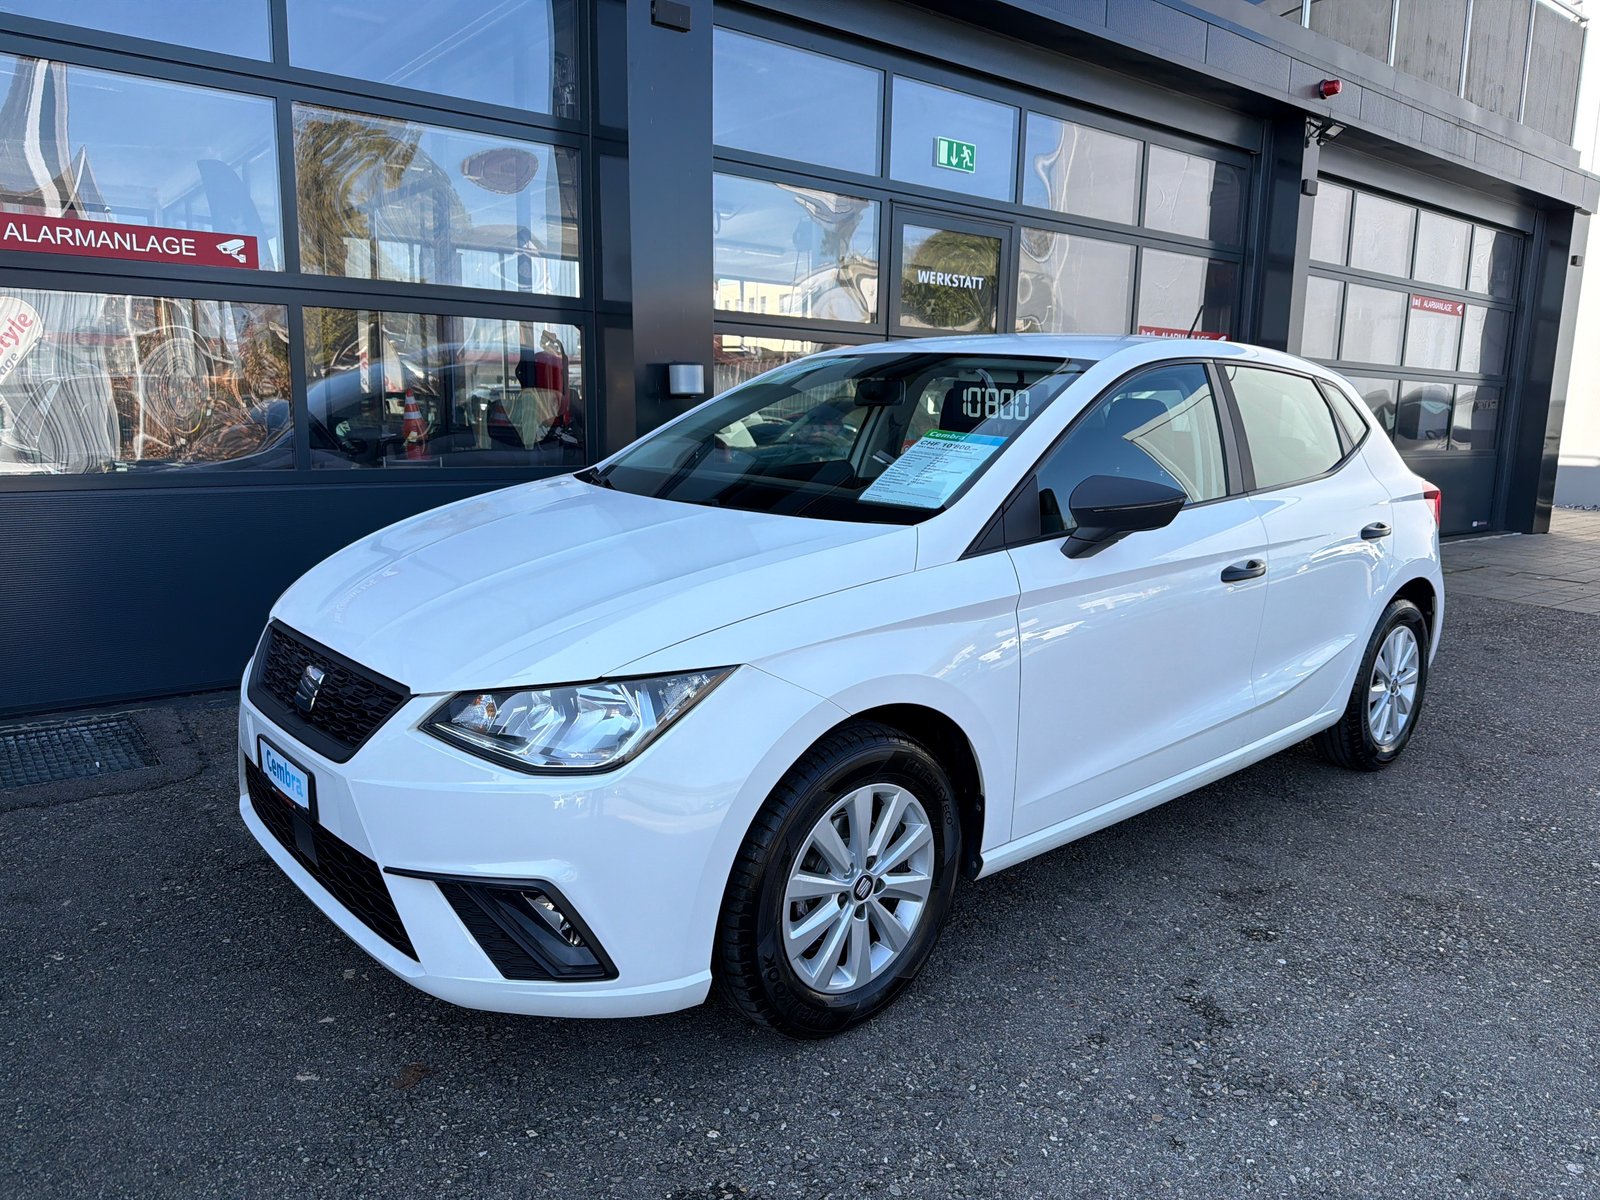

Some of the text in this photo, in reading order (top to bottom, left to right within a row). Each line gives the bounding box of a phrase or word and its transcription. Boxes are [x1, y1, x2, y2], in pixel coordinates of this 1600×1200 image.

[3, 222, 197, 256] ALARMANLAGE
[917, 269, 985, 291] WERKSTATT
[1423, 299, 1453, 312] ALARMANLAGE
[266, 749, 303, 798] Cembra
